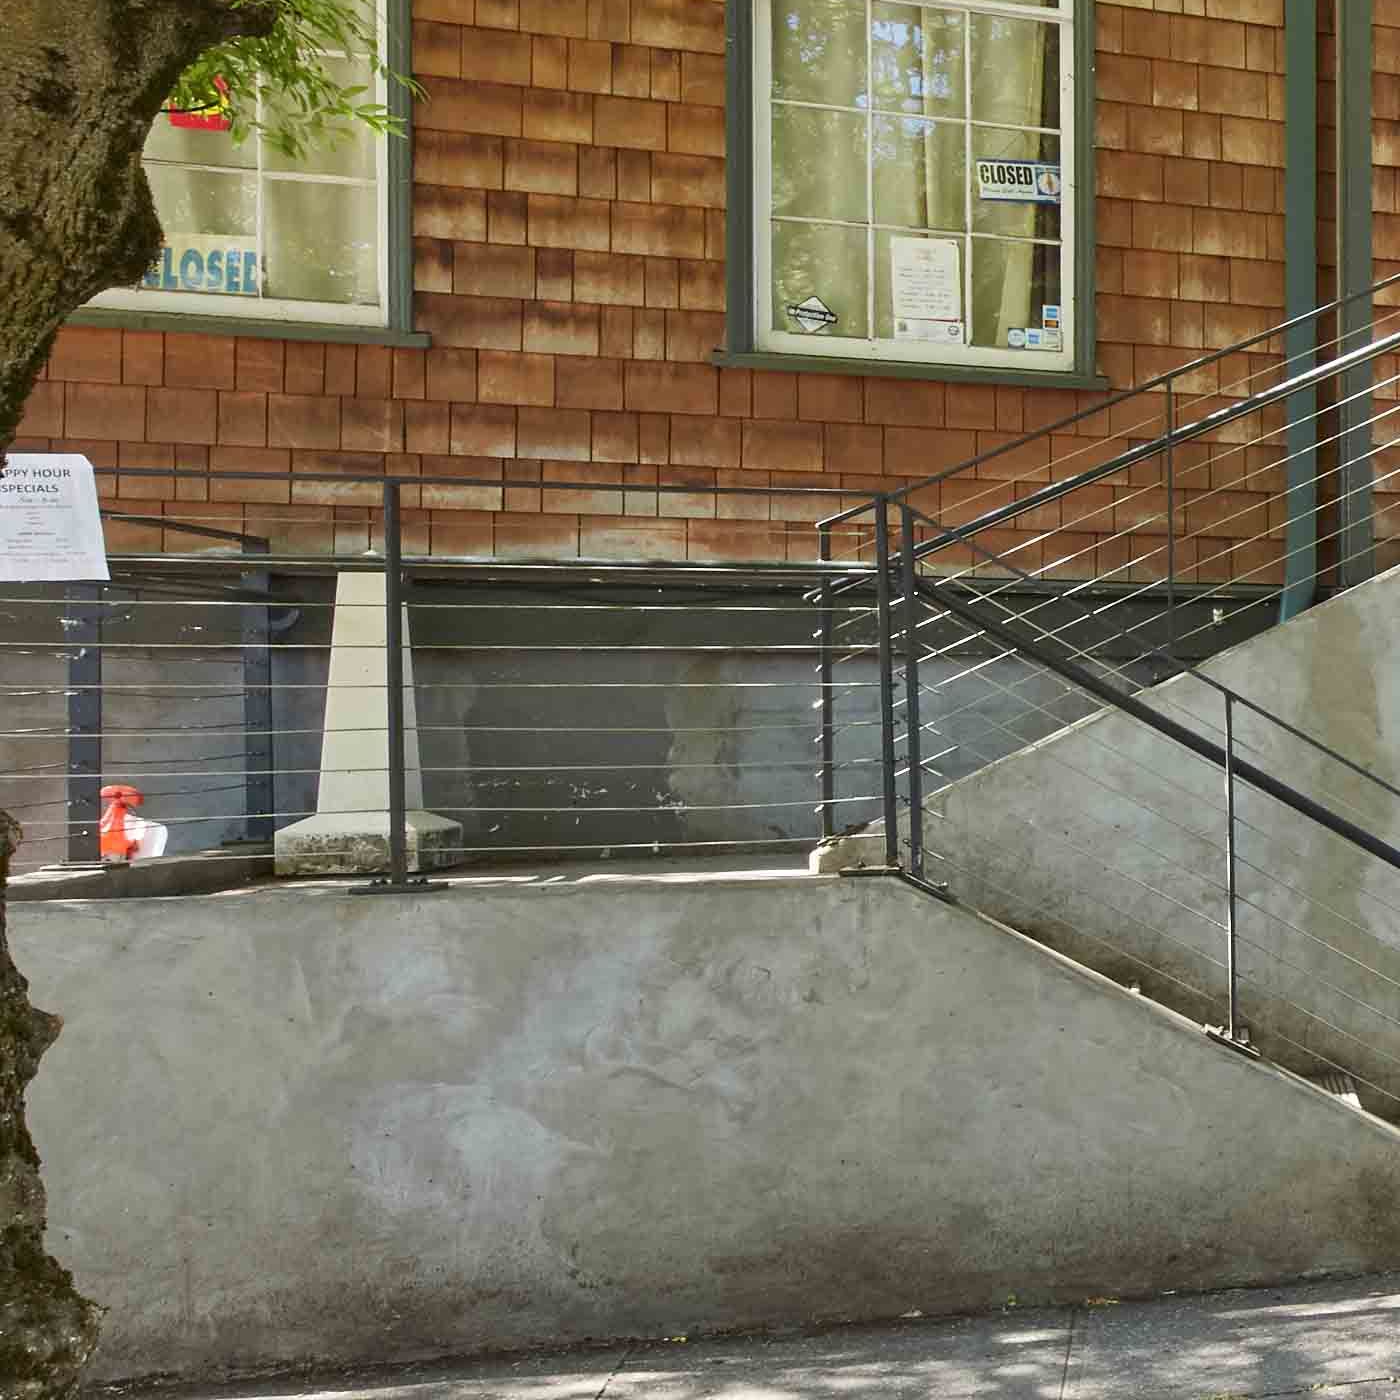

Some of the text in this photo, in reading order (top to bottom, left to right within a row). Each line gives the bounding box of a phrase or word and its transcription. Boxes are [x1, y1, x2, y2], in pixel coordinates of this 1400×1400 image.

[980, 164, 1033, 186] CLOSED
[3, 468, 71, 478] PPY HOUR
[1, 484, 59, 493] SPECIALS
